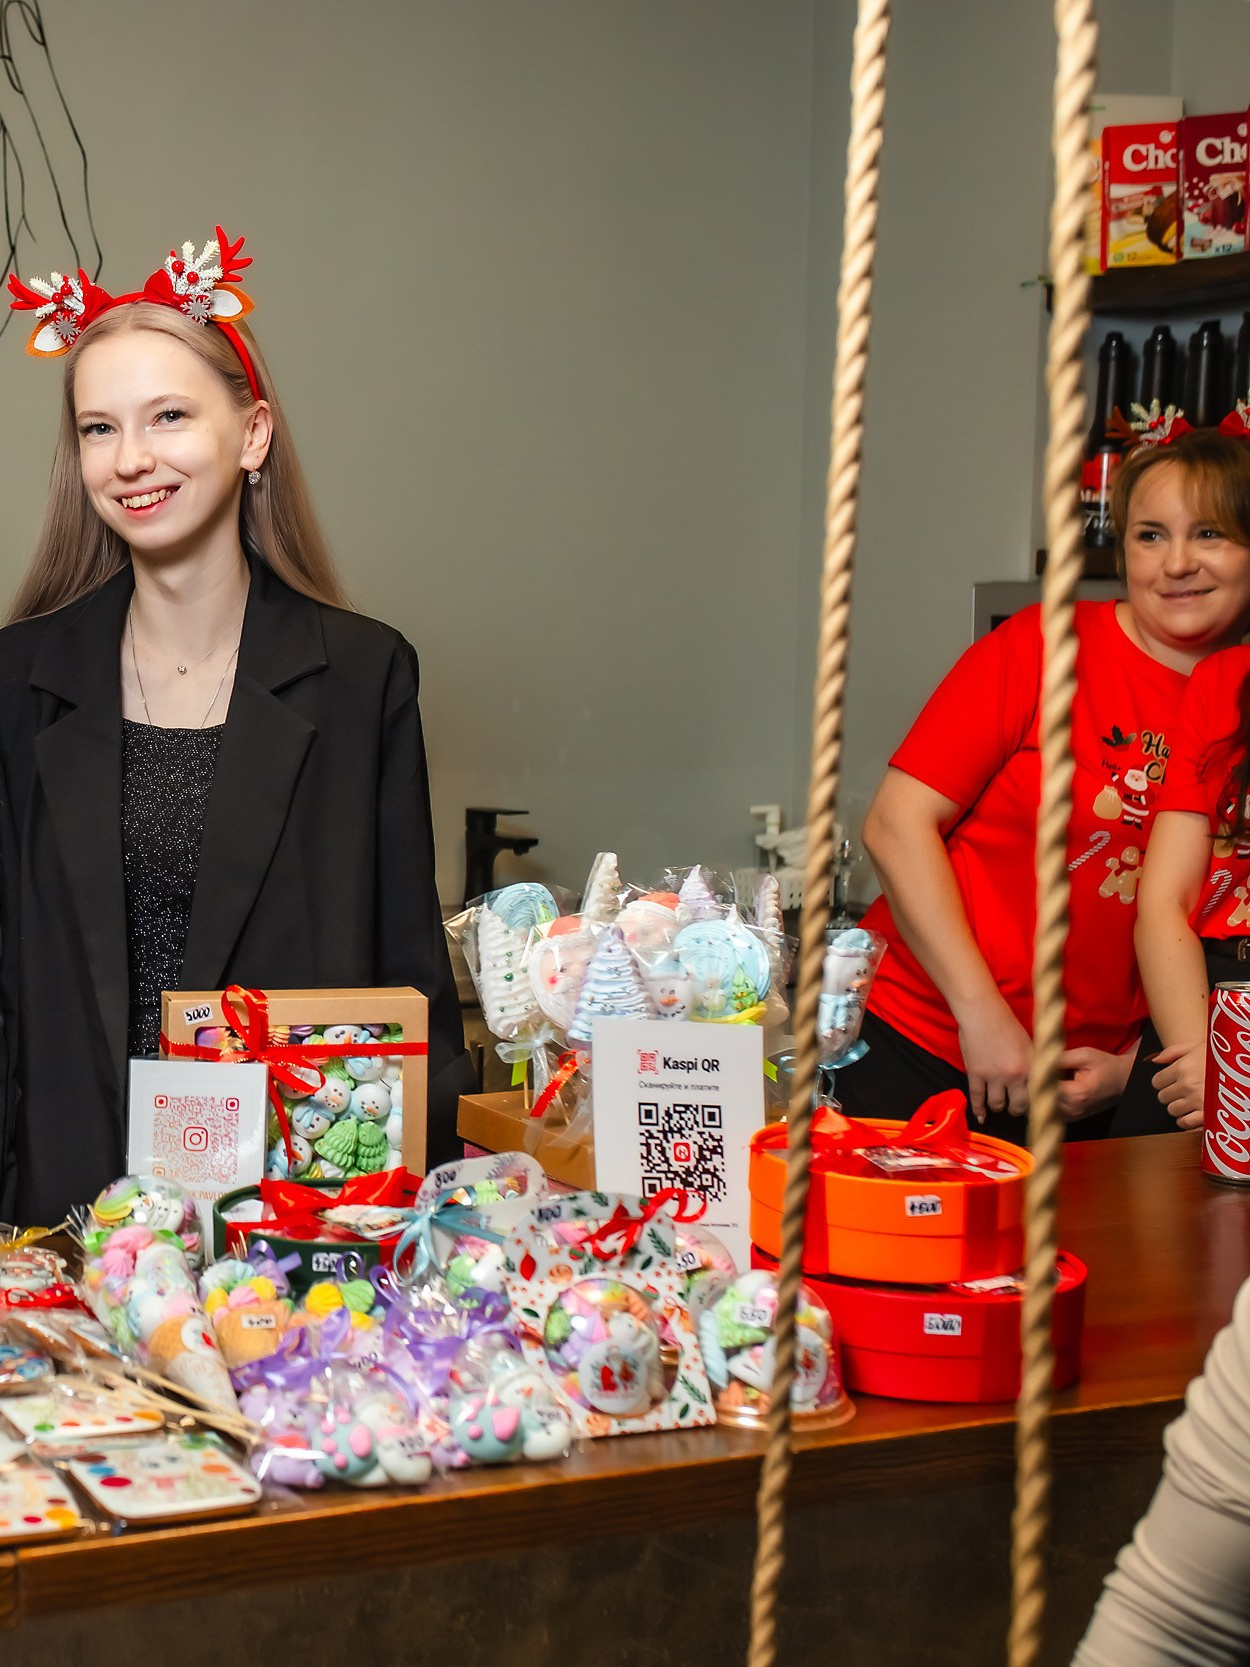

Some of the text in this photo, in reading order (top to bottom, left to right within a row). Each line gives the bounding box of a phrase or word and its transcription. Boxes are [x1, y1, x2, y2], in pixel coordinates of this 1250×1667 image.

[1195, 135, 1248, 168] Ch
[662, 1056, 720, 1074] Kaspi QR
[638, 1080, 682, 1091] Сканируйте
